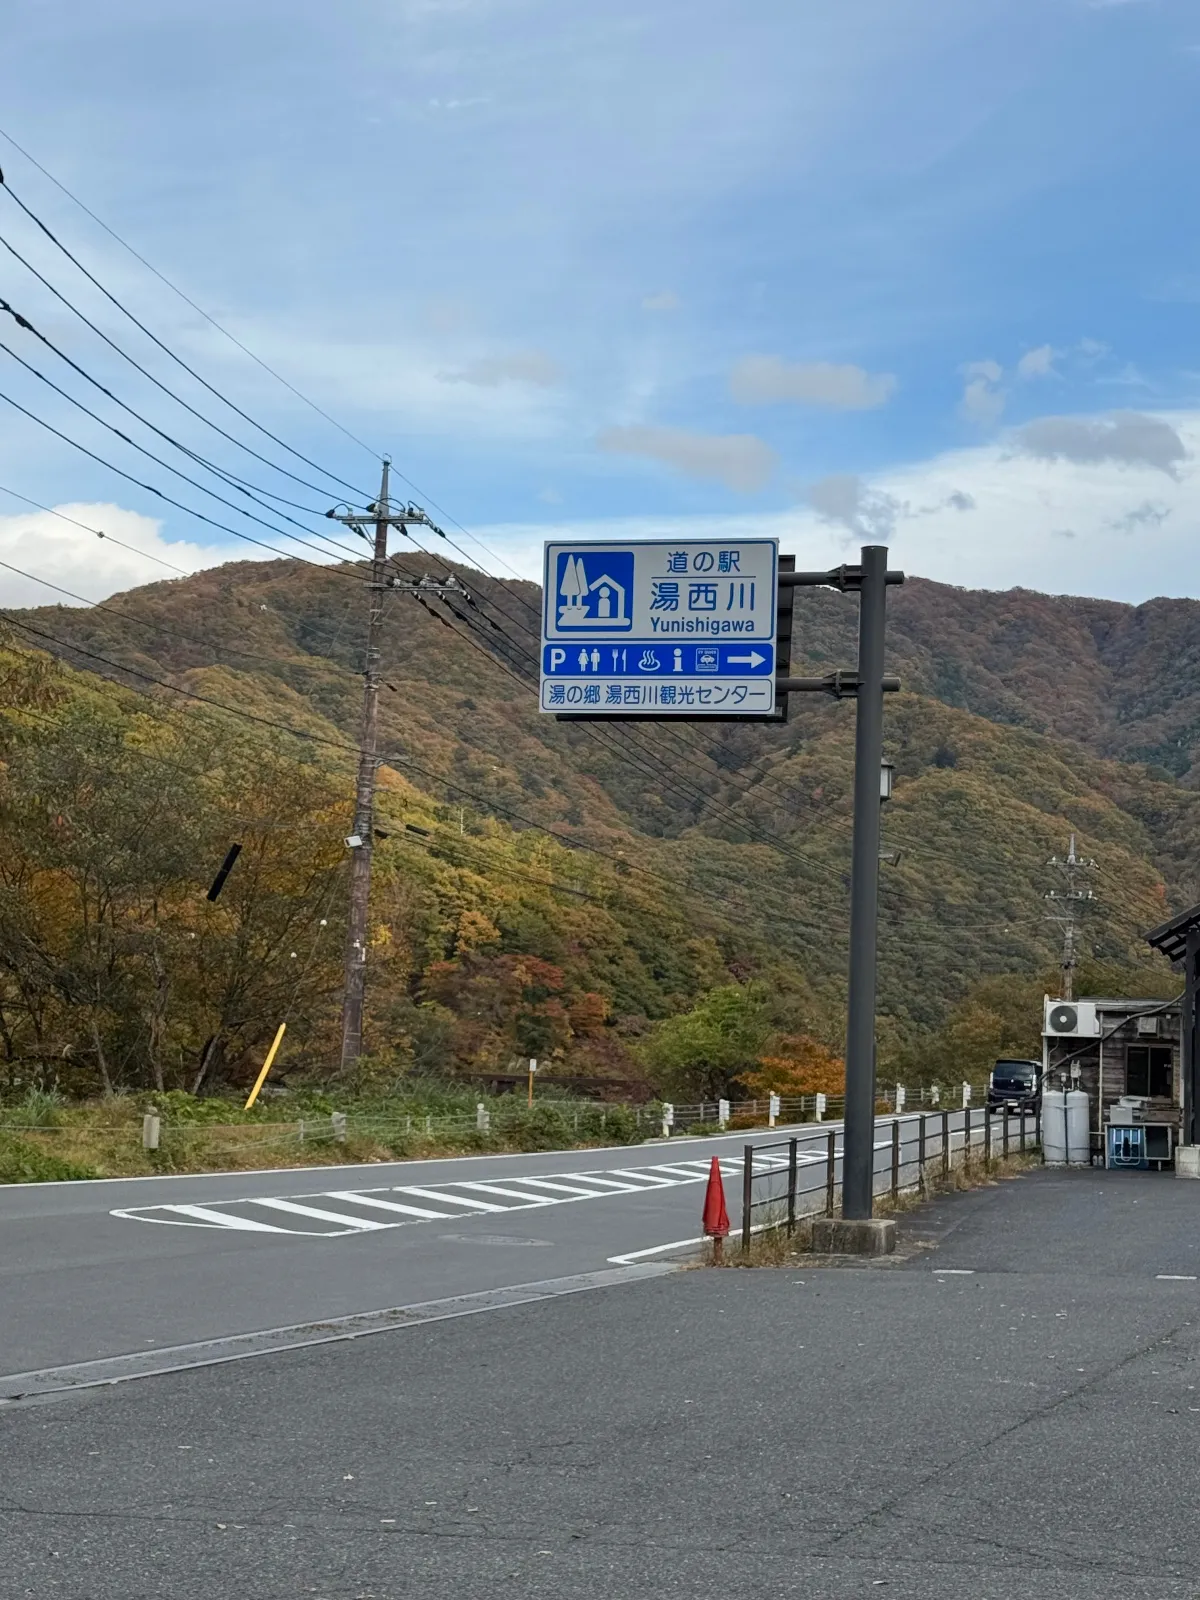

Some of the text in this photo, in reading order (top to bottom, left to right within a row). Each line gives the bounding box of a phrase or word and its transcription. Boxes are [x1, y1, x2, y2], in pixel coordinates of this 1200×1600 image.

[667, 551, 740, 573] 道の駅
[649, 582, 755, 611] 湯西川
[650, 617, 755, 635] Yunishigawa
[551, 648, 566, 672] P
[549, 684, 765, 705] 湯の郷 湯西川観光センター
